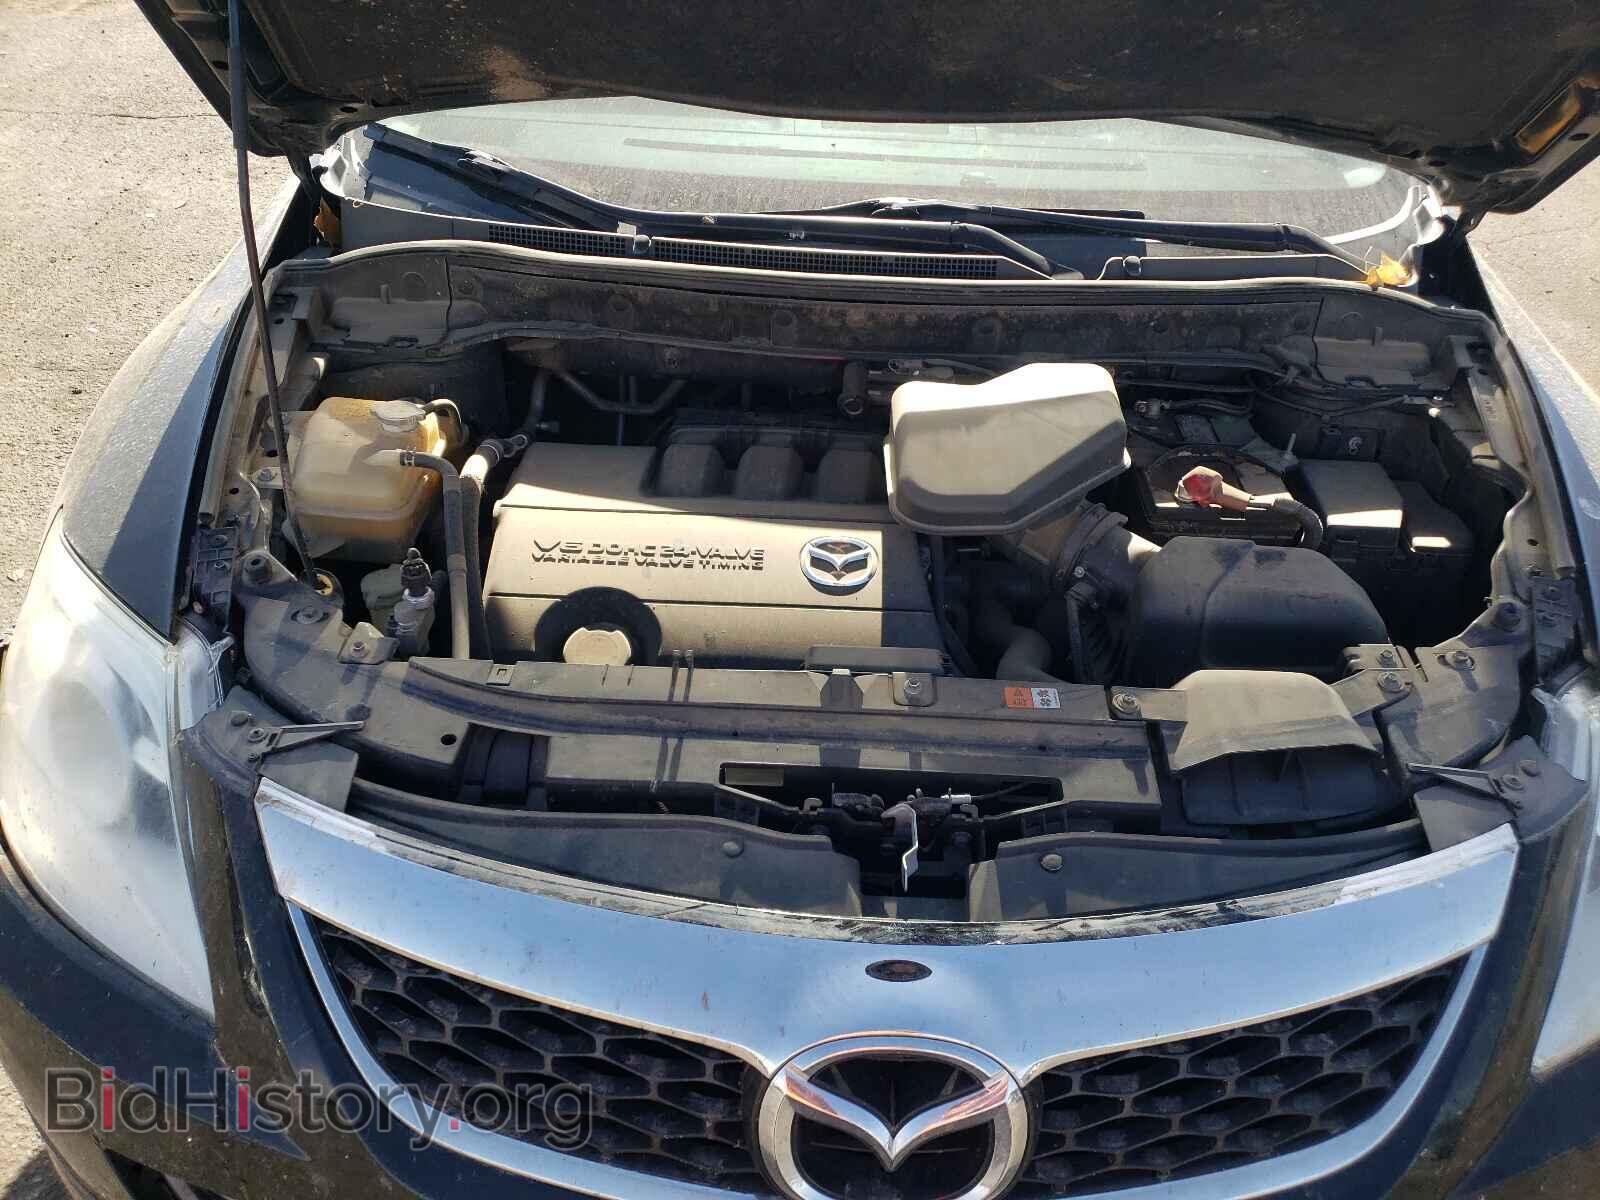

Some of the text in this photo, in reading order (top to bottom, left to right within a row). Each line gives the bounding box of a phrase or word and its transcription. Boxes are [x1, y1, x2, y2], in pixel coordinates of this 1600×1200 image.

[587, 542, 656, 556] DOHC
[660, 545, 764, 560] 24-VALVE
[531, 552, 764, 571] VARIABLE VALVE TIMING
